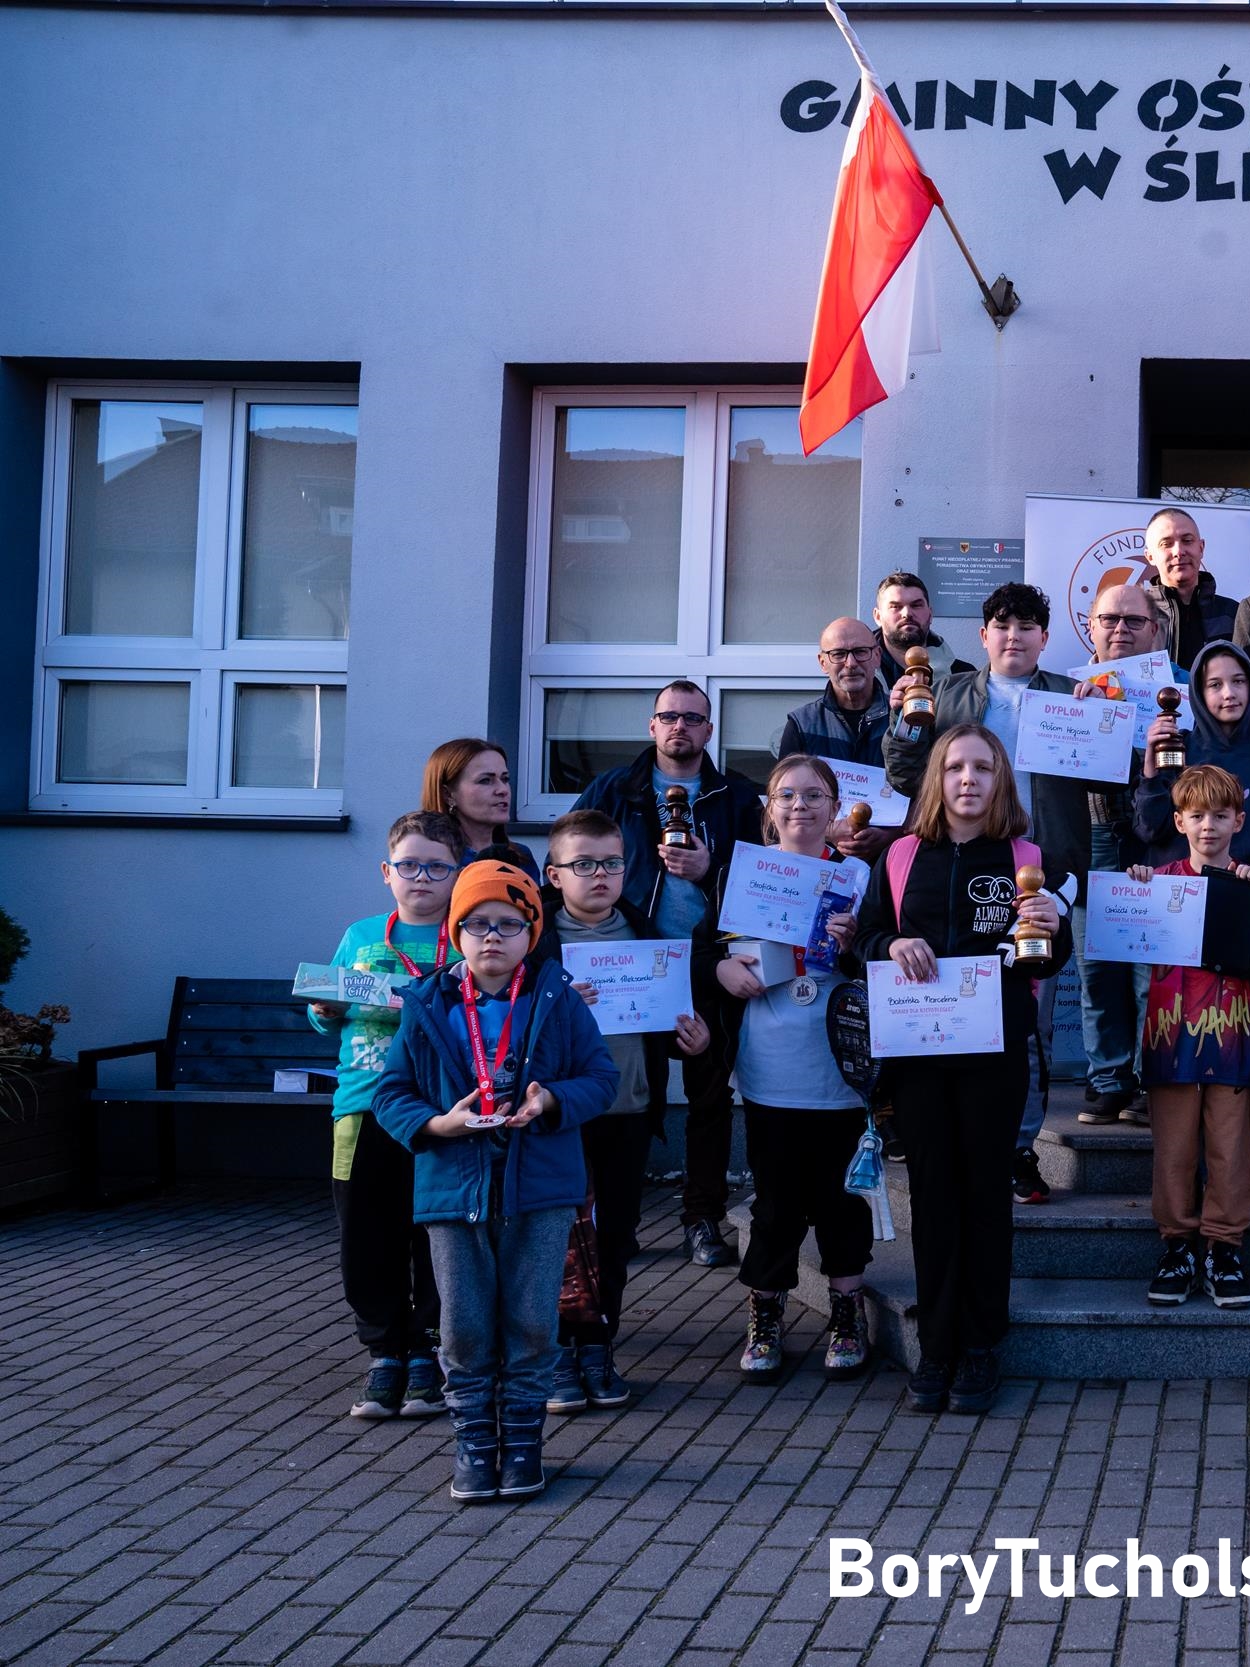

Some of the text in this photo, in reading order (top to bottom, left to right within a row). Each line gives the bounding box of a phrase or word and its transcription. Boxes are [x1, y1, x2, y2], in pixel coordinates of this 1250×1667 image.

[1044, 151, 1120, 204] W
[1092, 534, 1146, 565] FUND
[1124, 688, 1152, 698] YPLOM
[1044, 704, 1084, 718] DYPLOM
[836, 771, 868, 784] DYPLOM
[757, 860, 799, 878] DYPLOM
[1112, 886, 1152, 897] DYPLOM
[974, 905, 1010, 922] ALWAYS
[972, 922, 992, 933] HAVE
[590, 955, 634, 967] DYPLOM
[1059, 968, 1075, 977] acja
[344, 975, 375, 986] Multi
[347, 986, 370, 1001] City
[1058, 999, 1082, 1007] konta
